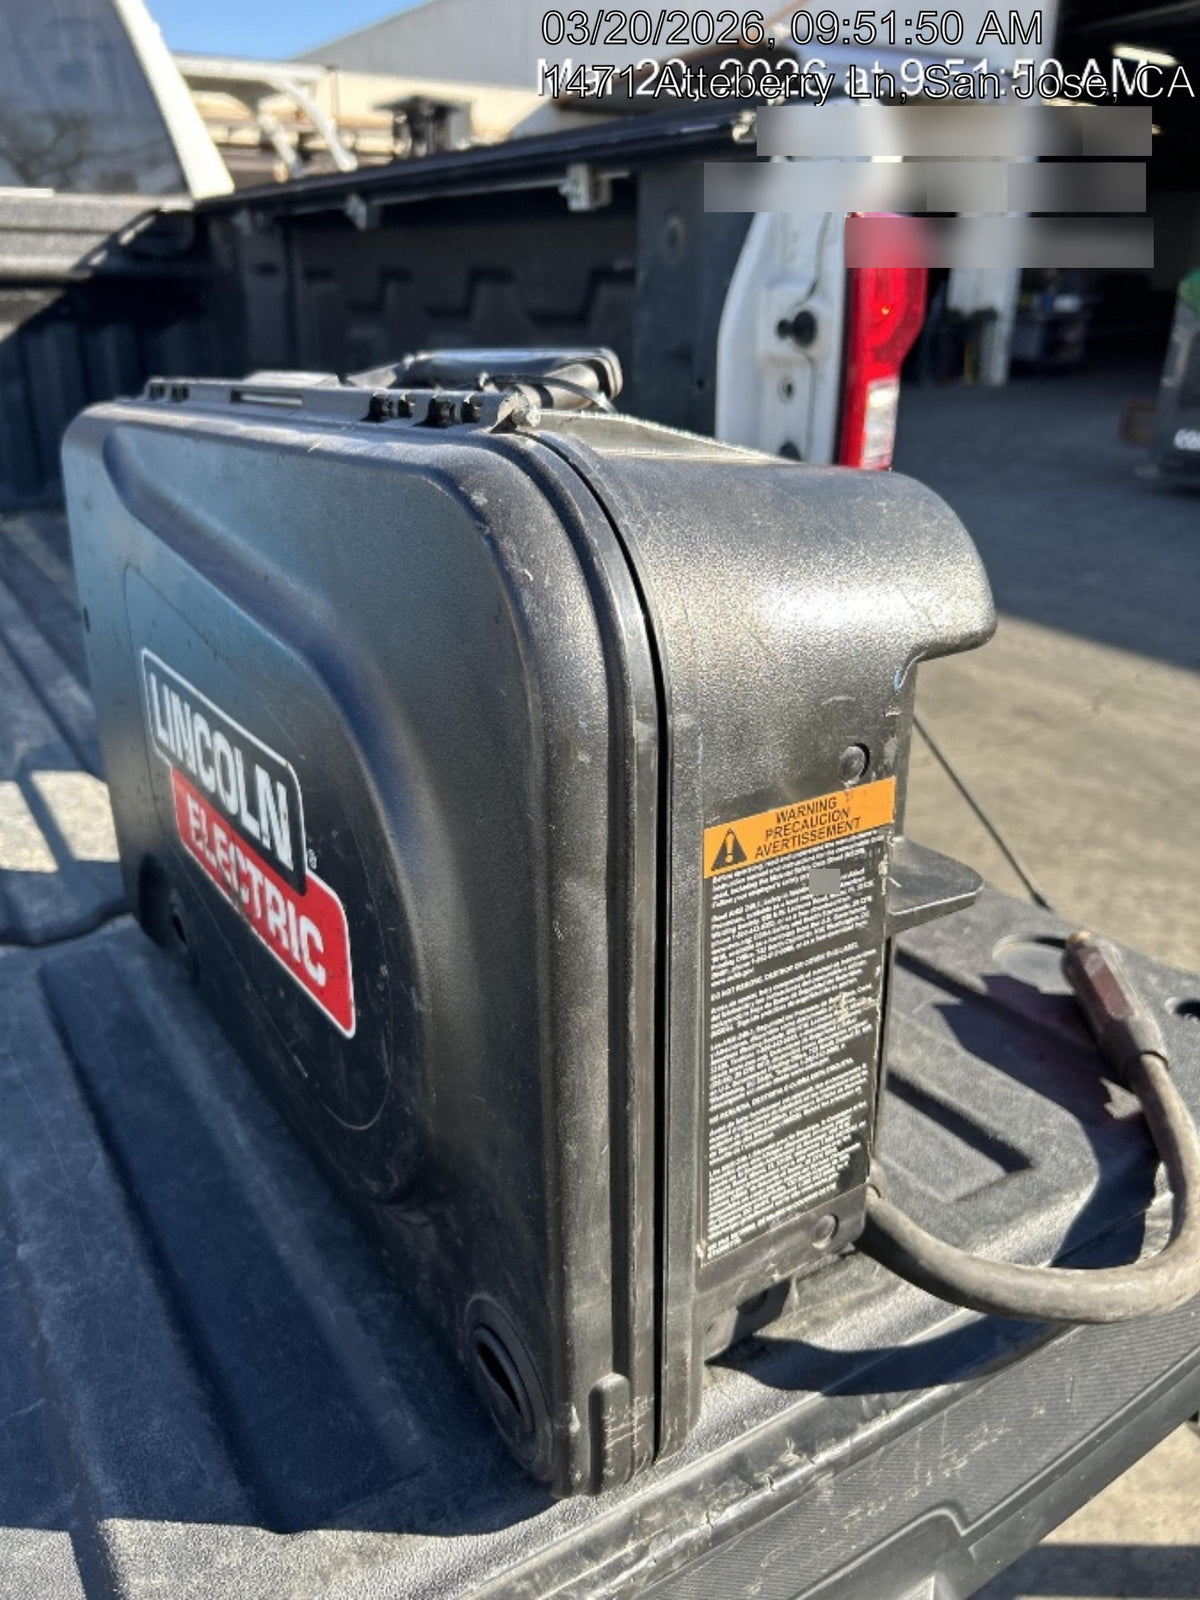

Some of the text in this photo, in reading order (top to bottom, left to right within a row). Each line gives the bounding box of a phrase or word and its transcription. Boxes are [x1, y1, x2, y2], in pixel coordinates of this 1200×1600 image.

[150, 673, 294, 872] LINCOLN
[765, 806, 852, 841] PRECAUCION
[776, 796, 838, 824] WARNING
[754, 817, 862, 860] AVERTISSEMENT
[186, 792, 327, 986] ELECTRIC
